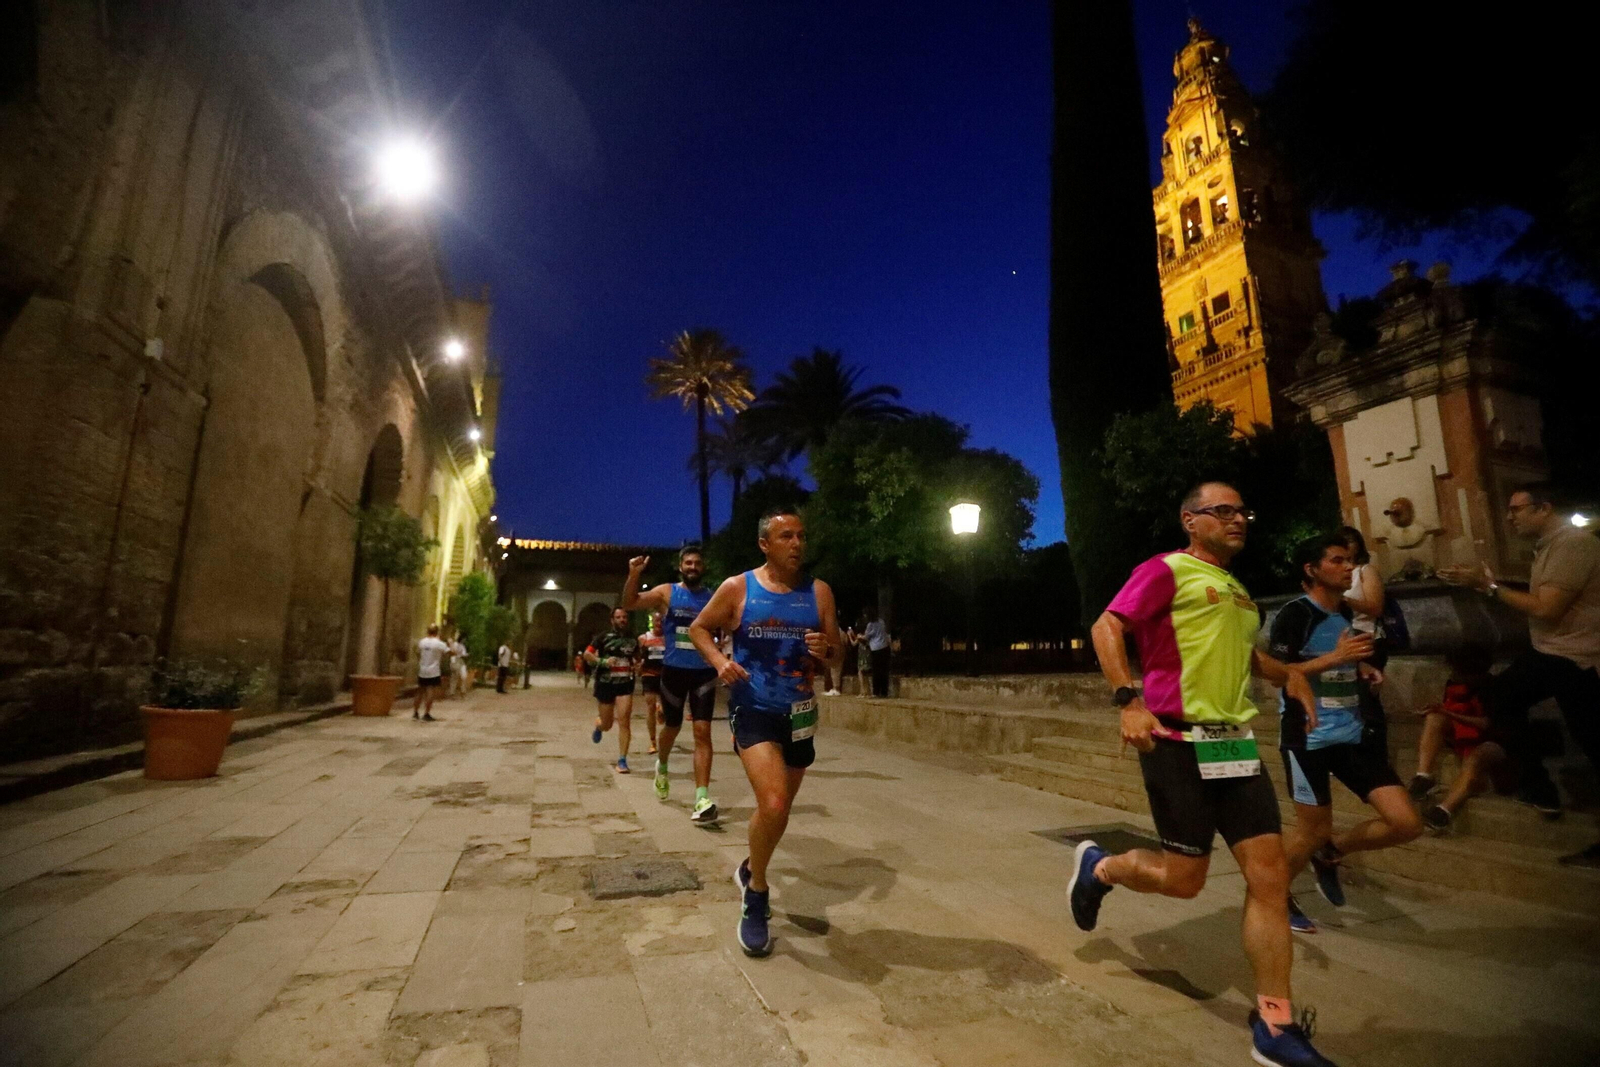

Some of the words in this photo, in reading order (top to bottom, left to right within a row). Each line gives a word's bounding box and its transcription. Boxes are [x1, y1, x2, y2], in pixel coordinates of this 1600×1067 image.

[748, 626, 763, 638] 20
[802, 701, 810, 711] 20
[1211, 740, 1240, 757] 596
